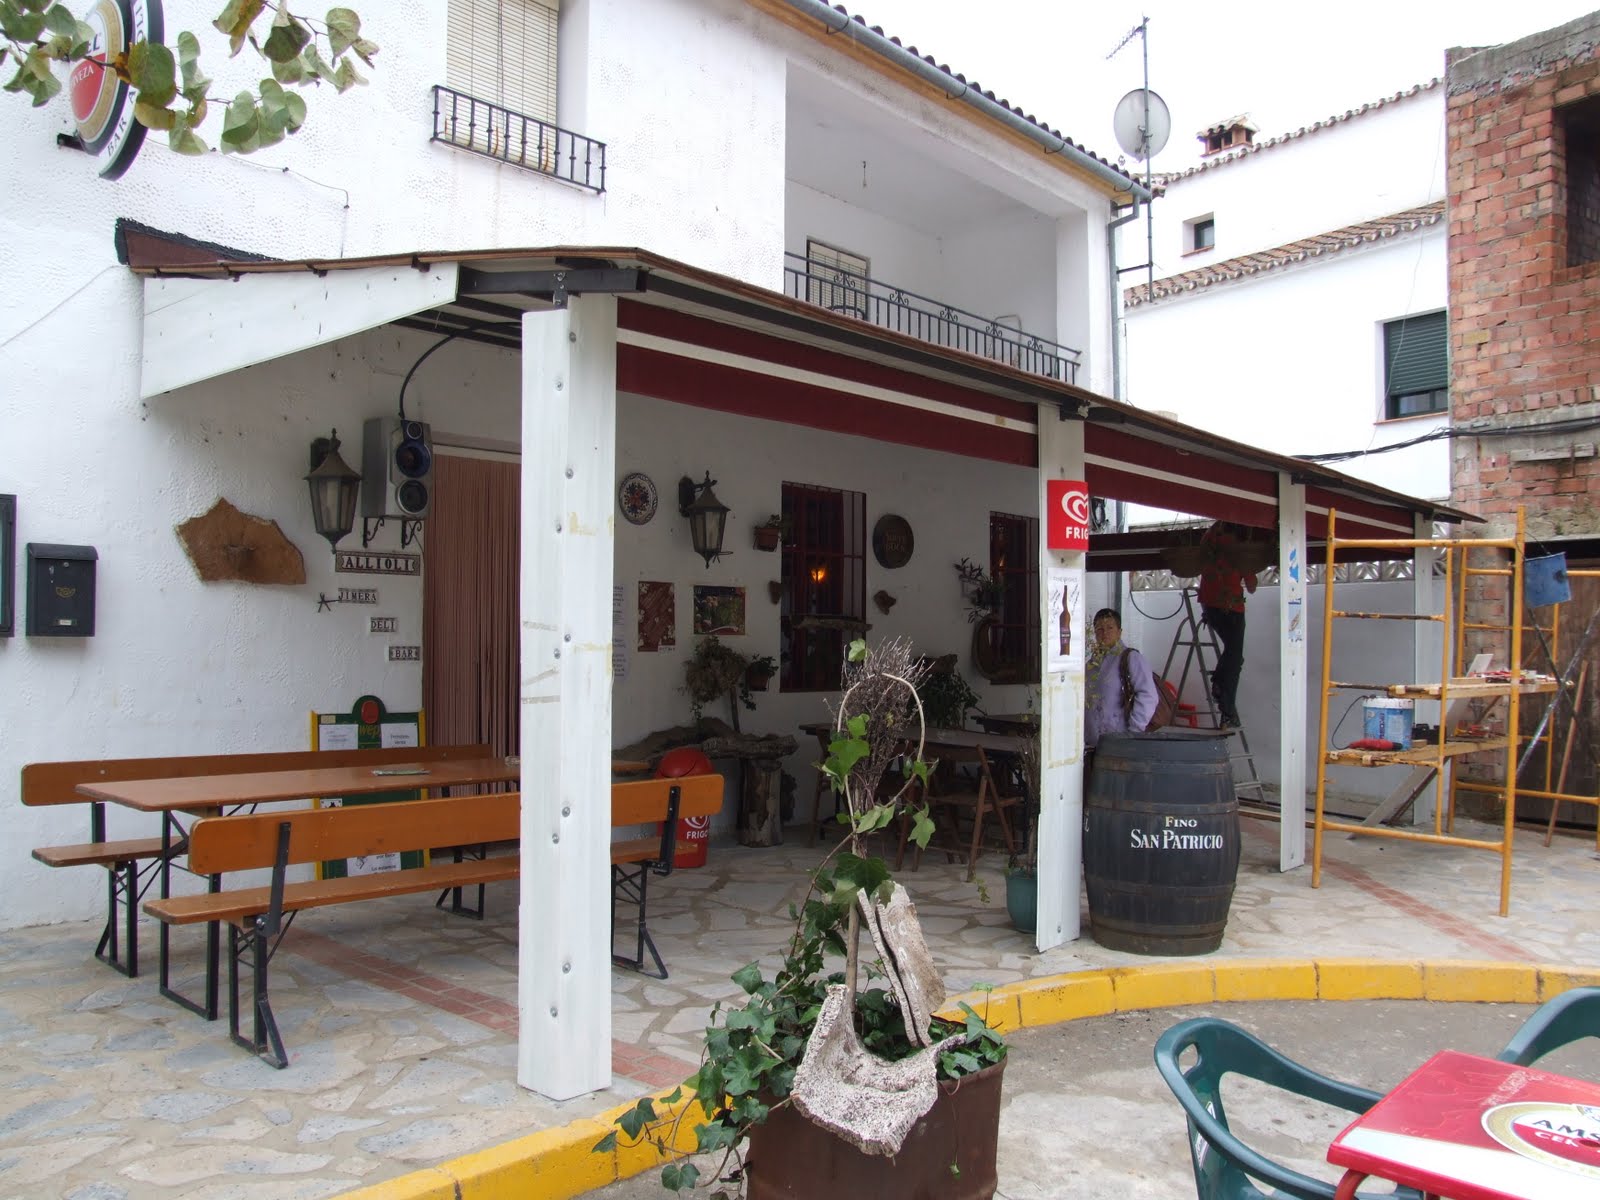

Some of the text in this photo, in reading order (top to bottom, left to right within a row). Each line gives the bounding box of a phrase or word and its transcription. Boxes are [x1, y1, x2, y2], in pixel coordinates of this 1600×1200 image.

[107, 116, 128, 157] BAR
[1066, 526, 1089, 540] FRIG
[345, 556, 410, 571] ALLIOLI
[338, 590, 377, 602] JIMERA
[371, 620, 395, 630] DELI
[395, 649, 413, 658] BAR
[1165, 816, 1197, 828] FINO
[1130, 829, 1223, 850] SAN PATRICIO
[1532, 1119, 1600, 1142] AMS
